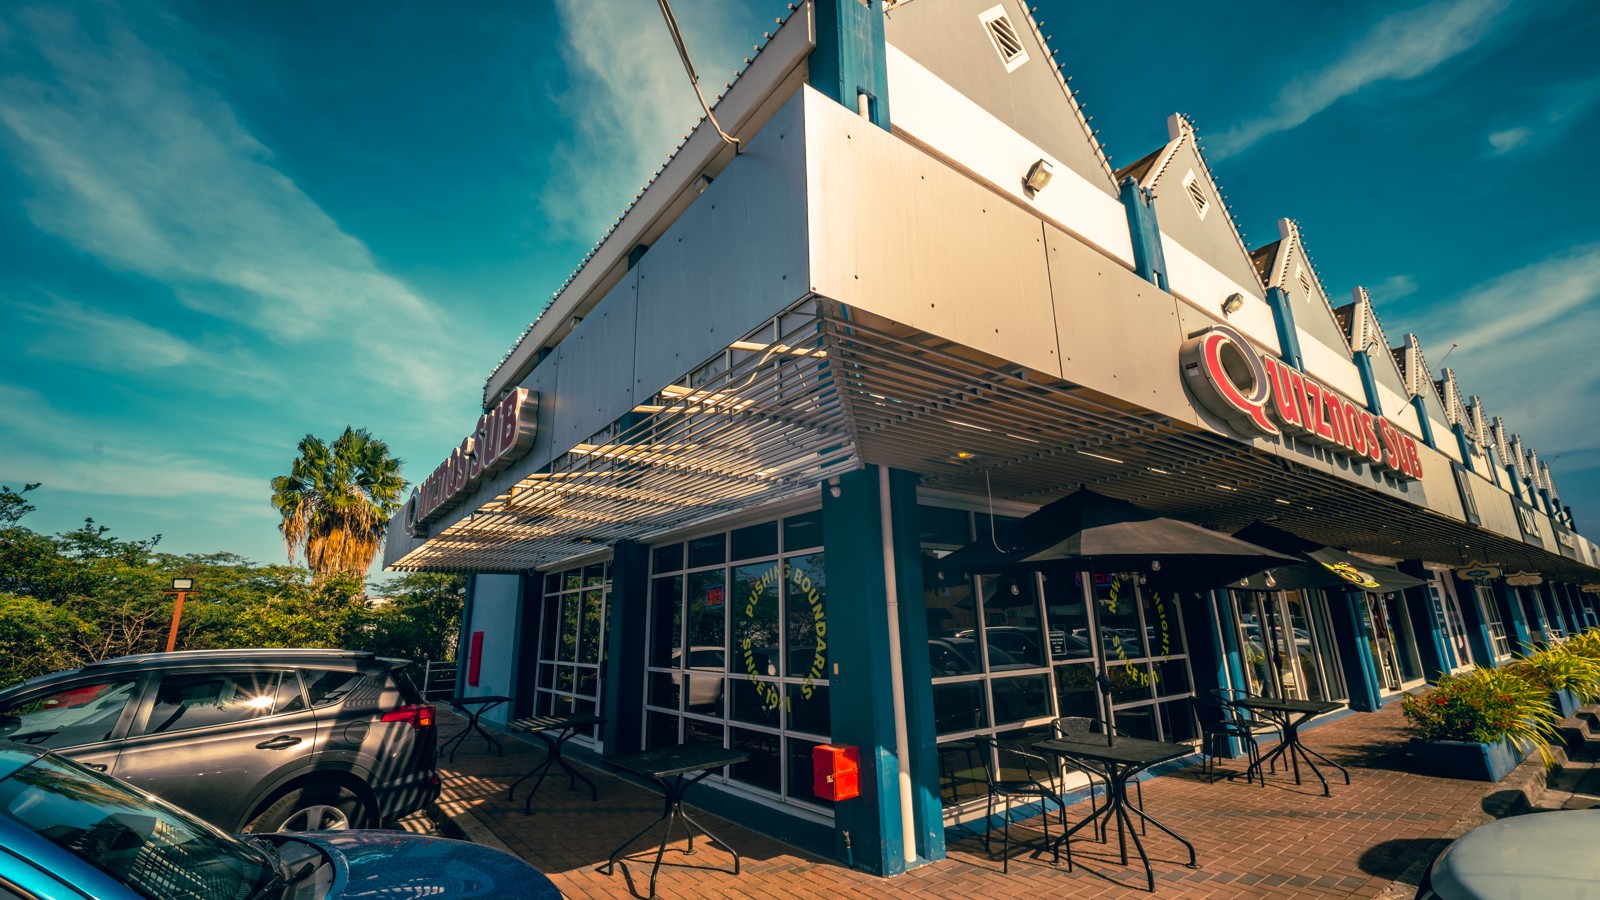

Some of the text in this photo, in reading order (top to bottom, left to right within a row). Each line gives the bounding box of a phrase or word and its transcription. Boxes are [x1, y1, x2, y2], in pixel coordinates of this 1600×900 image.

[470, 386, 522, 480] SUB
[1199, 324, 1424, 481] QUIZNOS SUB
[745, 563, 791, 618] PUSHING
[742, 637, 766, 696] SINCE
